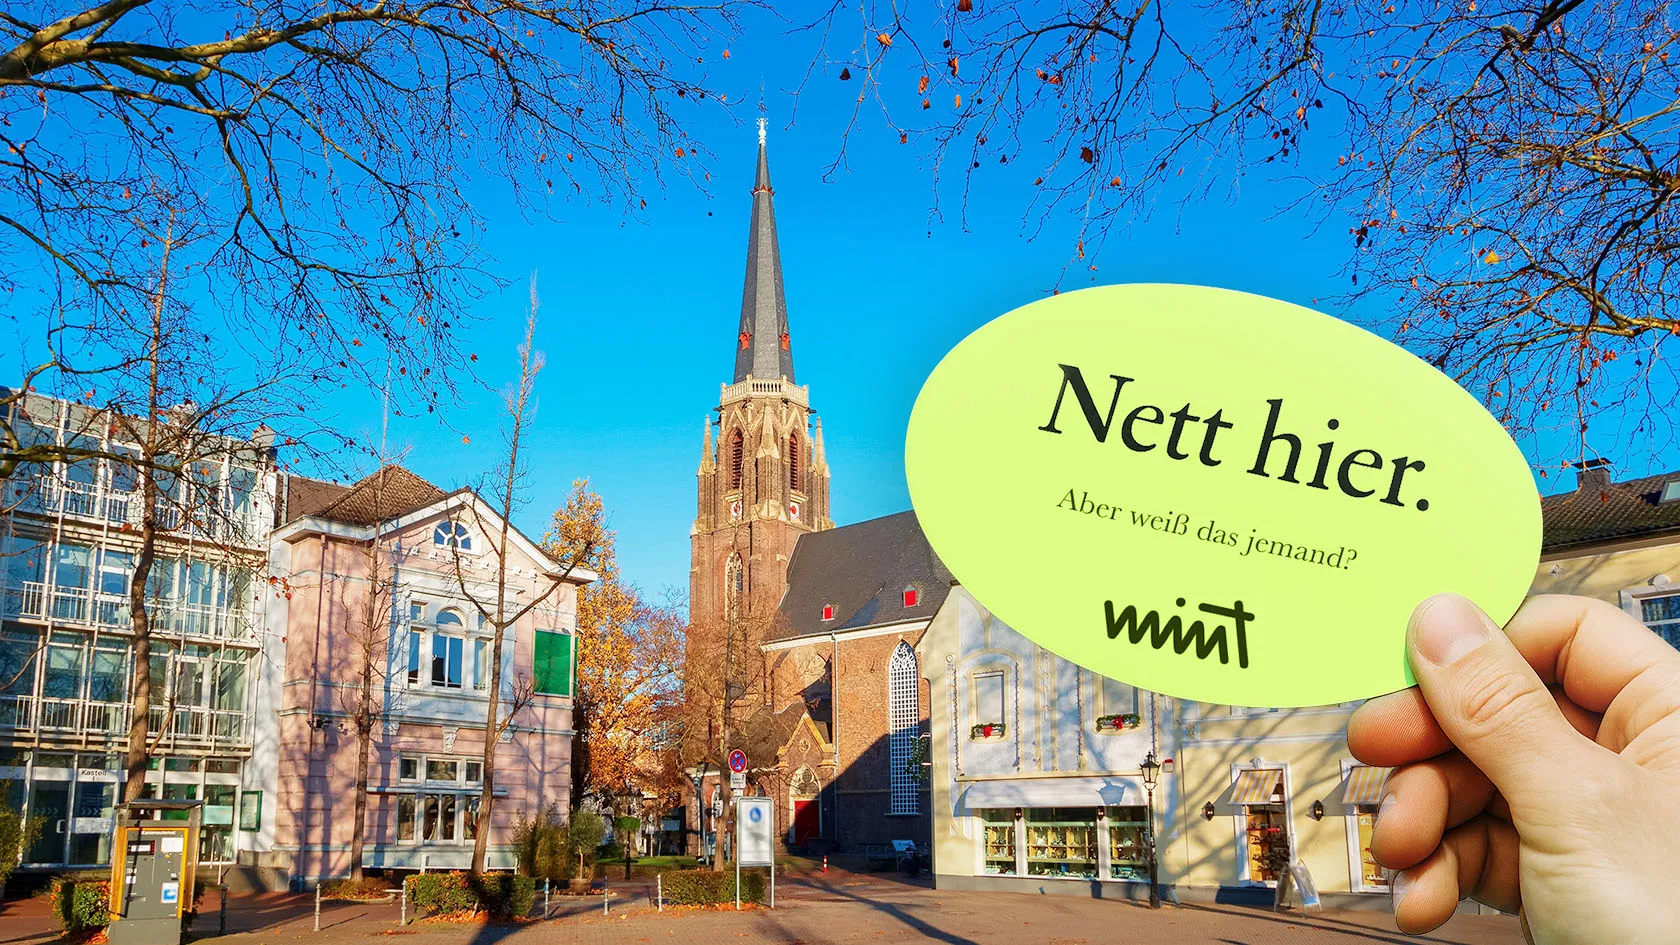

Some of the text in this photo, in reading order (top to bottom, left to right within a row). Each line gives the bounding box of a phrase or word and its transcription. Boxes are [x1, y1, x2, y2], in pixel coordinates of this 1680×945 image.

[1038, 363, 1430, 512] Nett hier.
[1056, 488, 1358, 570] Aber weiß das jemand?
